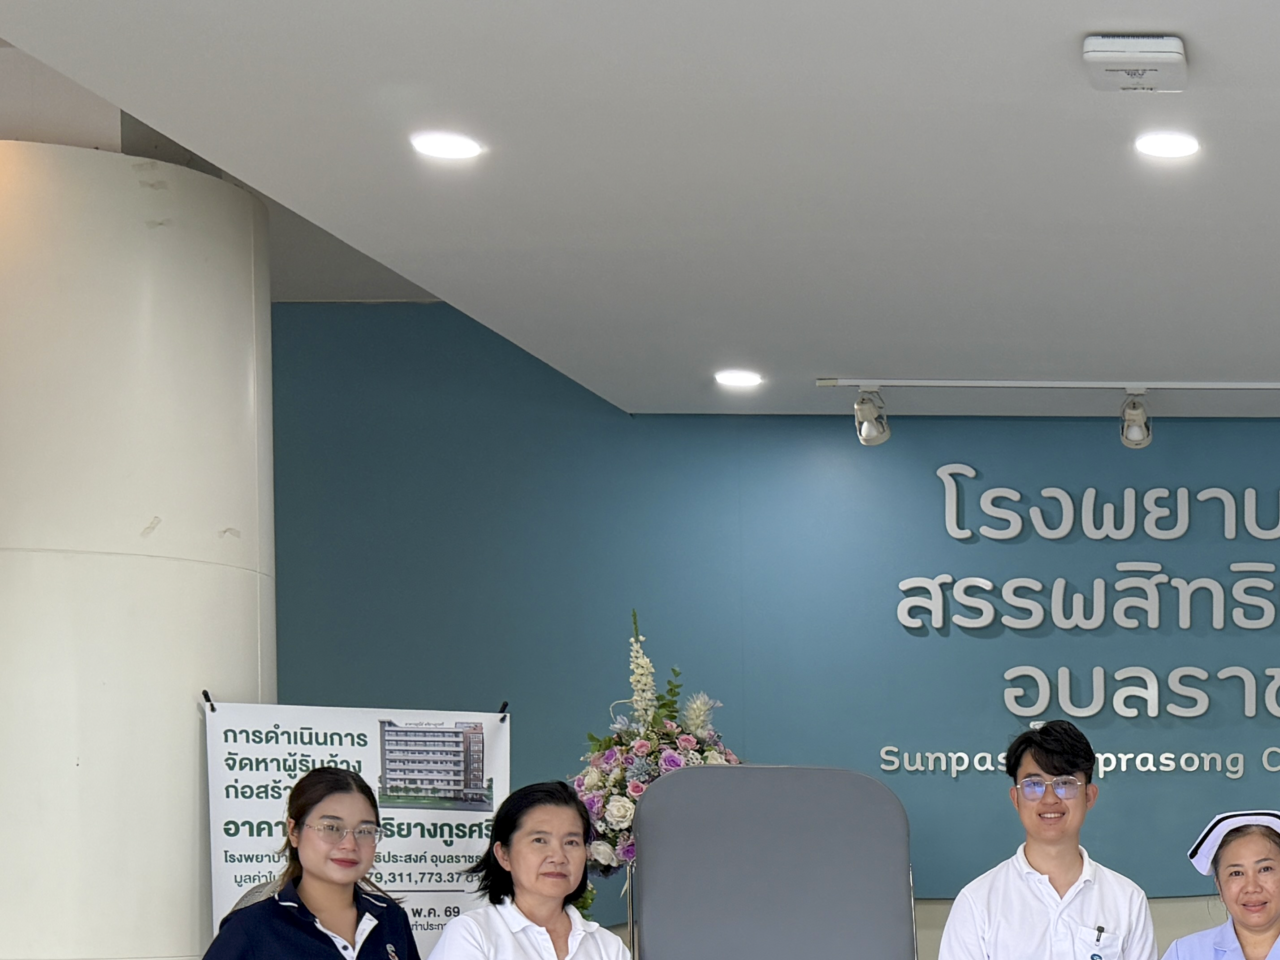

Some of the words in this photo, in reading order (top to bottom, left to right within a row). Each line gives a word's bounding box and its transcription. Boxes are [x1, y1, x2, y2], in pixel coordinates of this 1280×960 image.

[223, 723, 369, 747] การดำเนินการ
[880, 746, 1245, 779] Sunpasprasong
[223, 820, 288, 837] อาคา
[444, 906, 460, 917] 69
